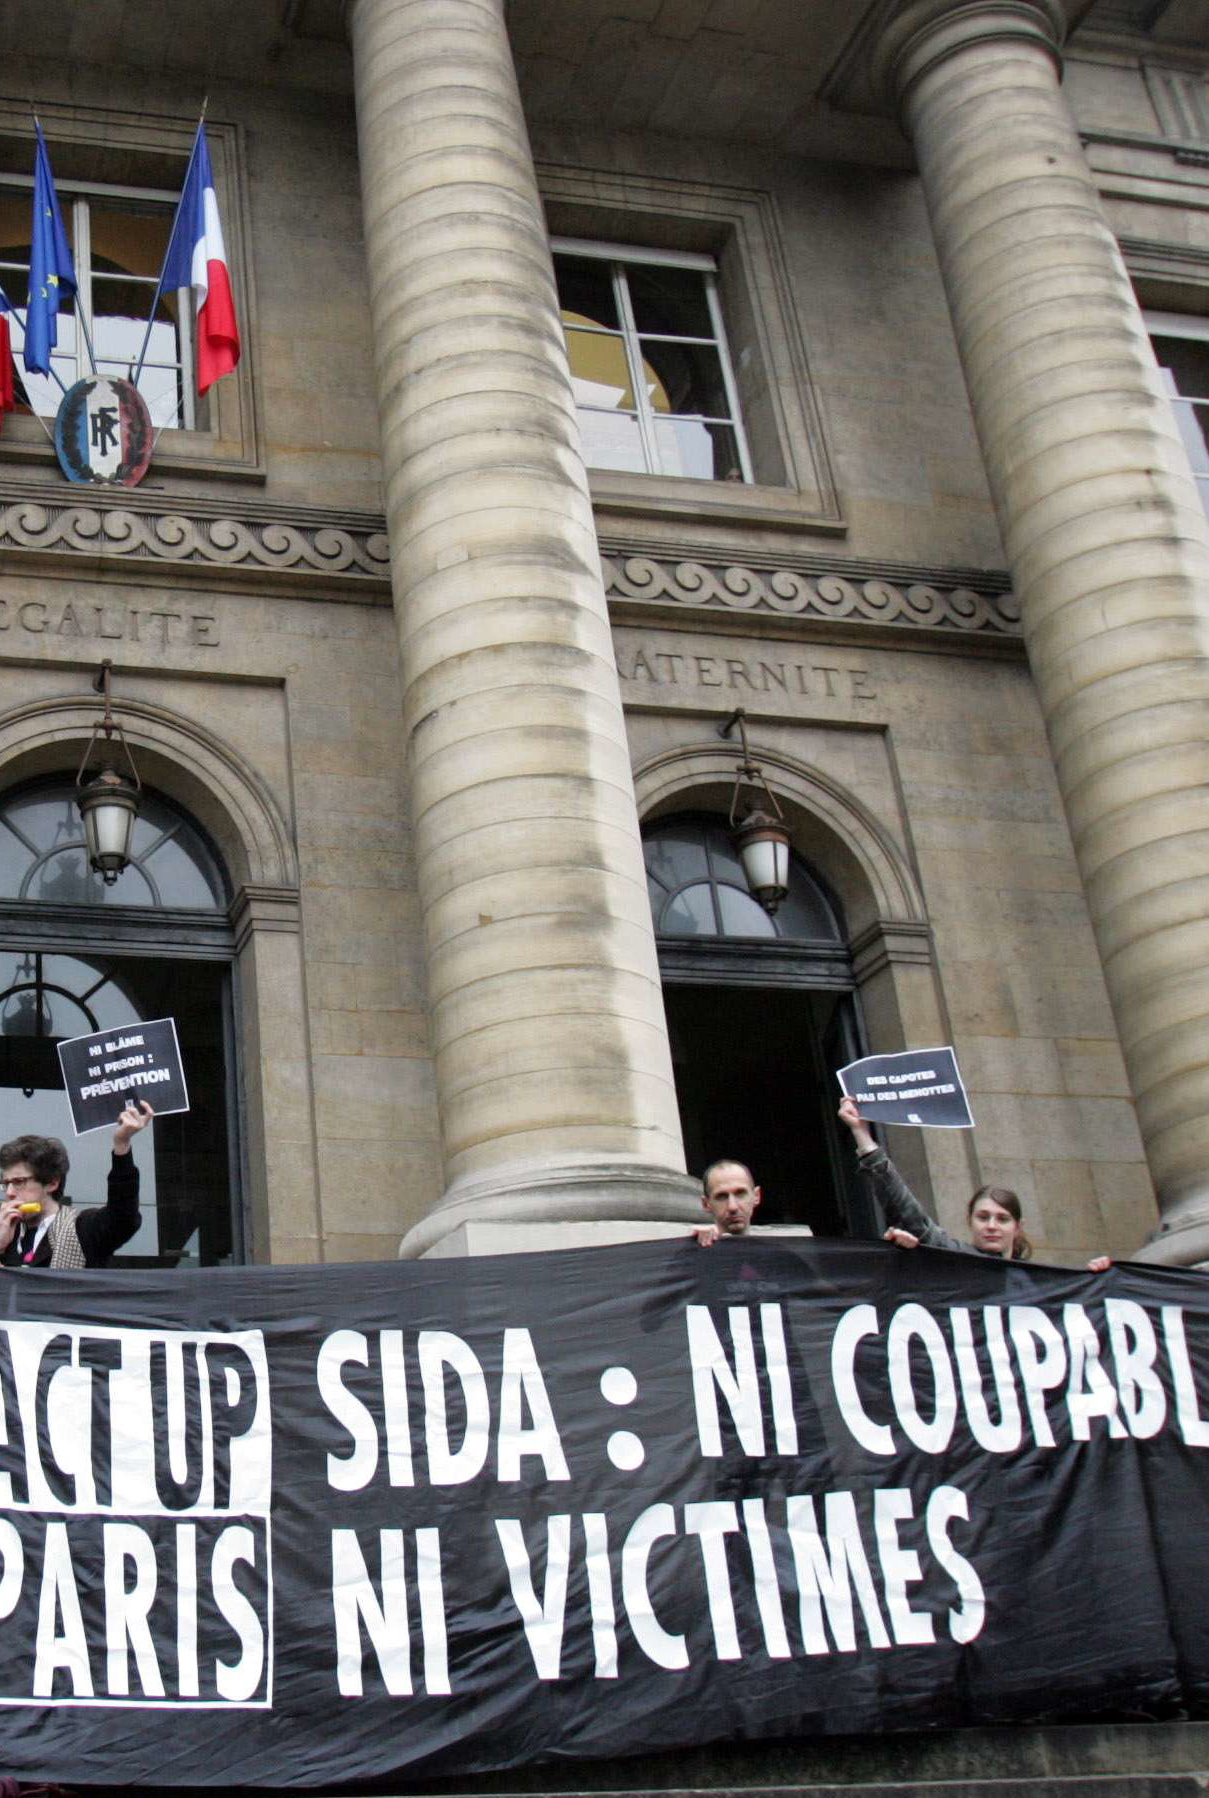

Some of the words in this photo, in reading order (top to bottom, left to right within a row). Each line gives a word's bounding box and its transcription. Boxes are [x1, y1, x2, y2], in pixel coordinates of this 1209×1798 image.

[617, 649, 877, 700] ATERNITE
[88, 1066, 100, 1076] NI
[104, 1055, 144, 1072] PRISON
[89, 1045, 102, 1056] NI
[80, 1068, 170, 1099] PRÉVENTION
[317, 1328, 571, 1492] SIDA
[686, 1303, 799, 1458] NI
[831, 1297, 1209, 1455] COUPABL
[149, 1340, 259, 1511] UP
[332, 1527, 451, 1697] NI
[494, 1485, 986, 1681] VICTIMES
